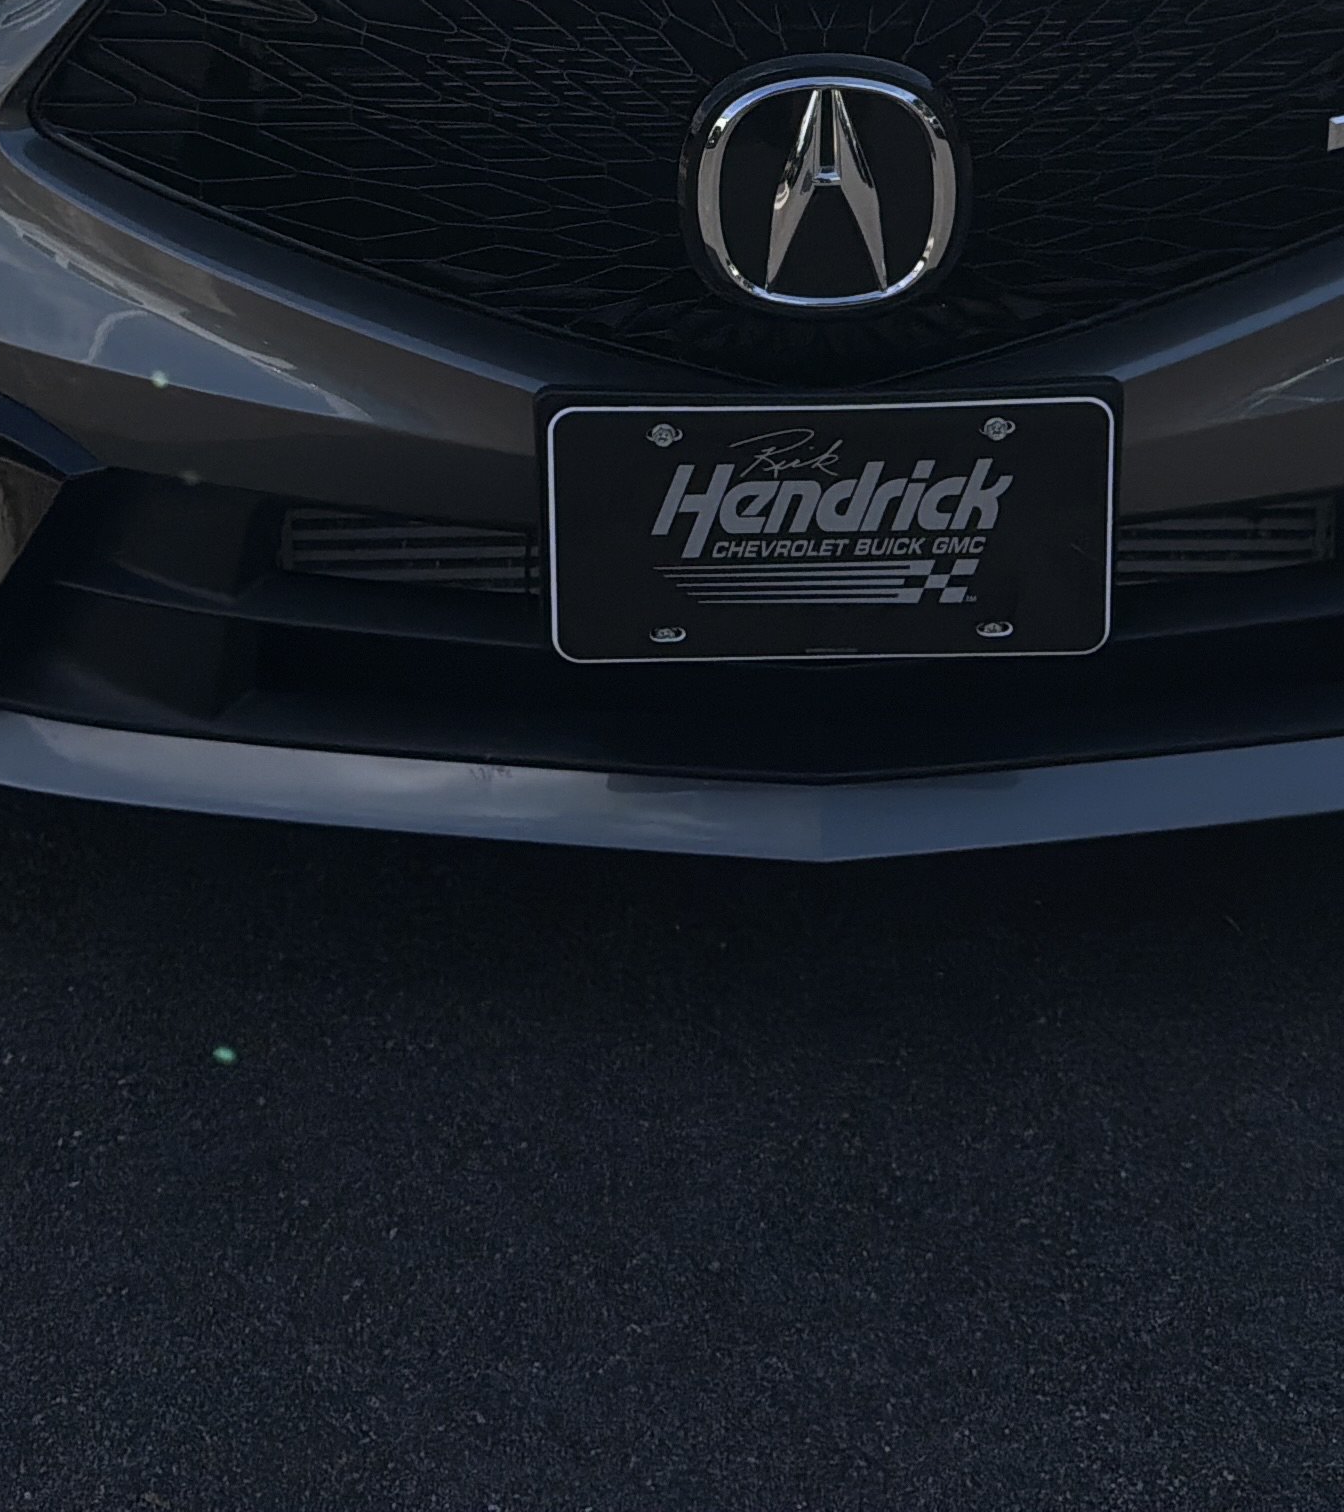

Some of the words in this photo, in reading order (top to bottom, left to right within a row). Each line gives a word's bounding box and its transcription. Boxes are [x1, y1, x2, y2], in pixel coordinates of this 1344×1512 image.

[651, 458, 1014, 559] Hendrick
[711, 539, 849, 559] CHEVROLET
[855, 537, 926, 557] BUICK
[932, 536, 986, 555] GMC
